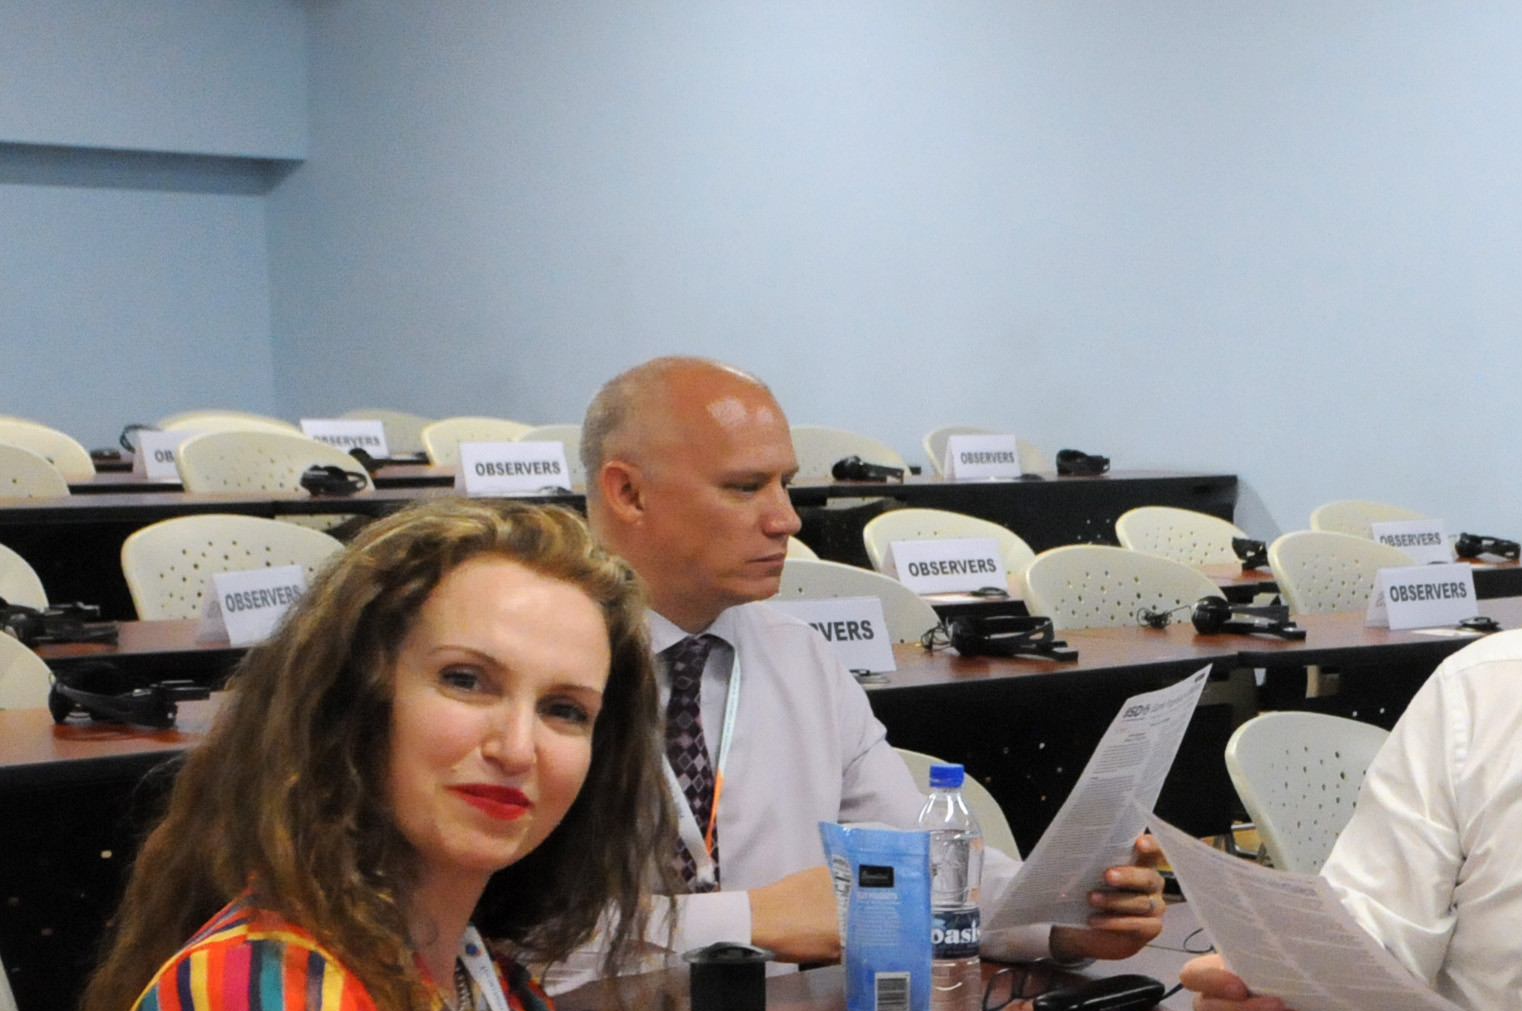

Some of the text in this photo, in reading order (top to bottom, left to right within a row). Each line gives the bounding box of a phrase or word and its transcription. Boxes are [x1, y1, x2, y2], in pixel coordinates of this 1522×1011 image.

[960, 451, 1015, 465] OBSERVERS
[475, 461, 561, 476] OBSERVERS
[1380, 532, 1442, 547] OBSERVERS
[908, 558, 997, 577] OBSERVERS
[225, 584, 301, 613] OBSERVERS
[1389, 582, 1467, 602] OBSERVERS
